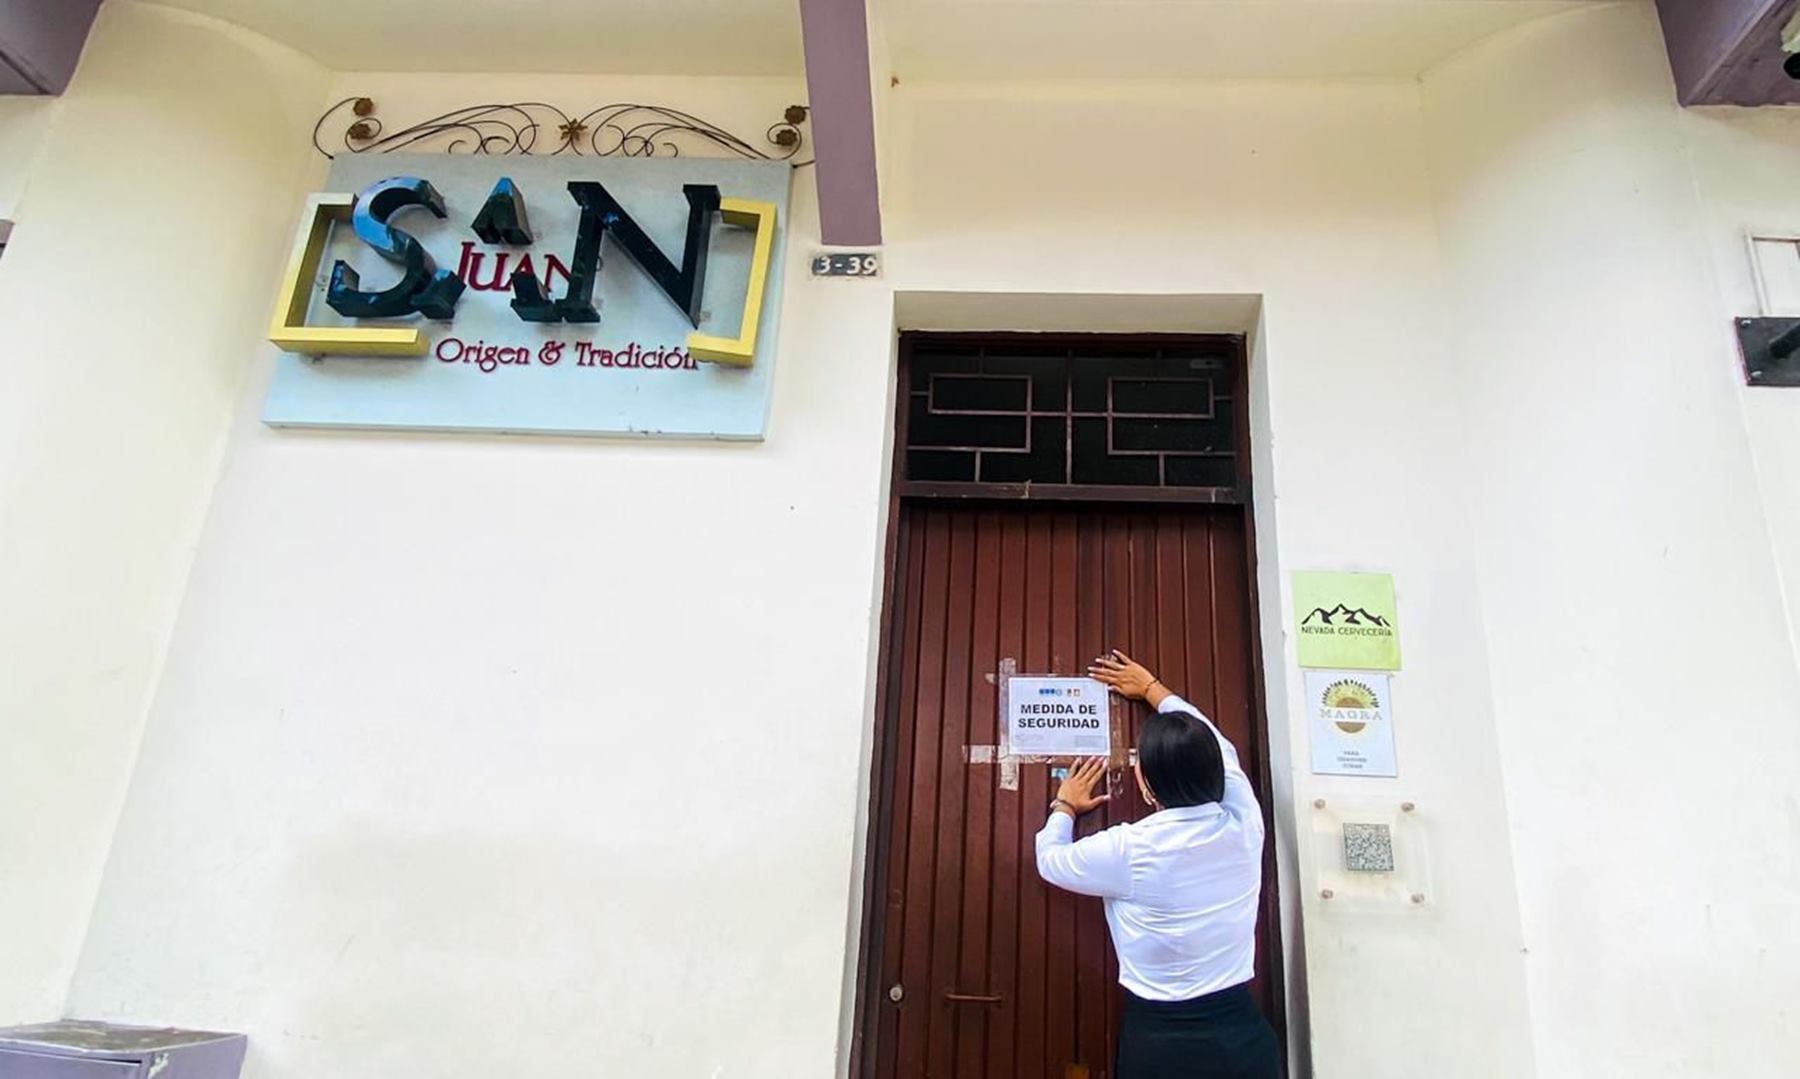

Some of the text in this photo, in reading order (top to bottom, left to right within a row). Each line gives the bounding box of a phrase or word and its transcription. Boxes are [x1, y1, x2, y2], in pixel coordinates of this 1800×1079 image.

[436, 338, 530, 373] Origen
[538, 341, 566, 365] &
[1301, 626, 1335, 635] NEVADA
[1020, 704, 1097, 715] MEDIDA DE
[1018, 718, 1100, 729] SEGURIDAD
